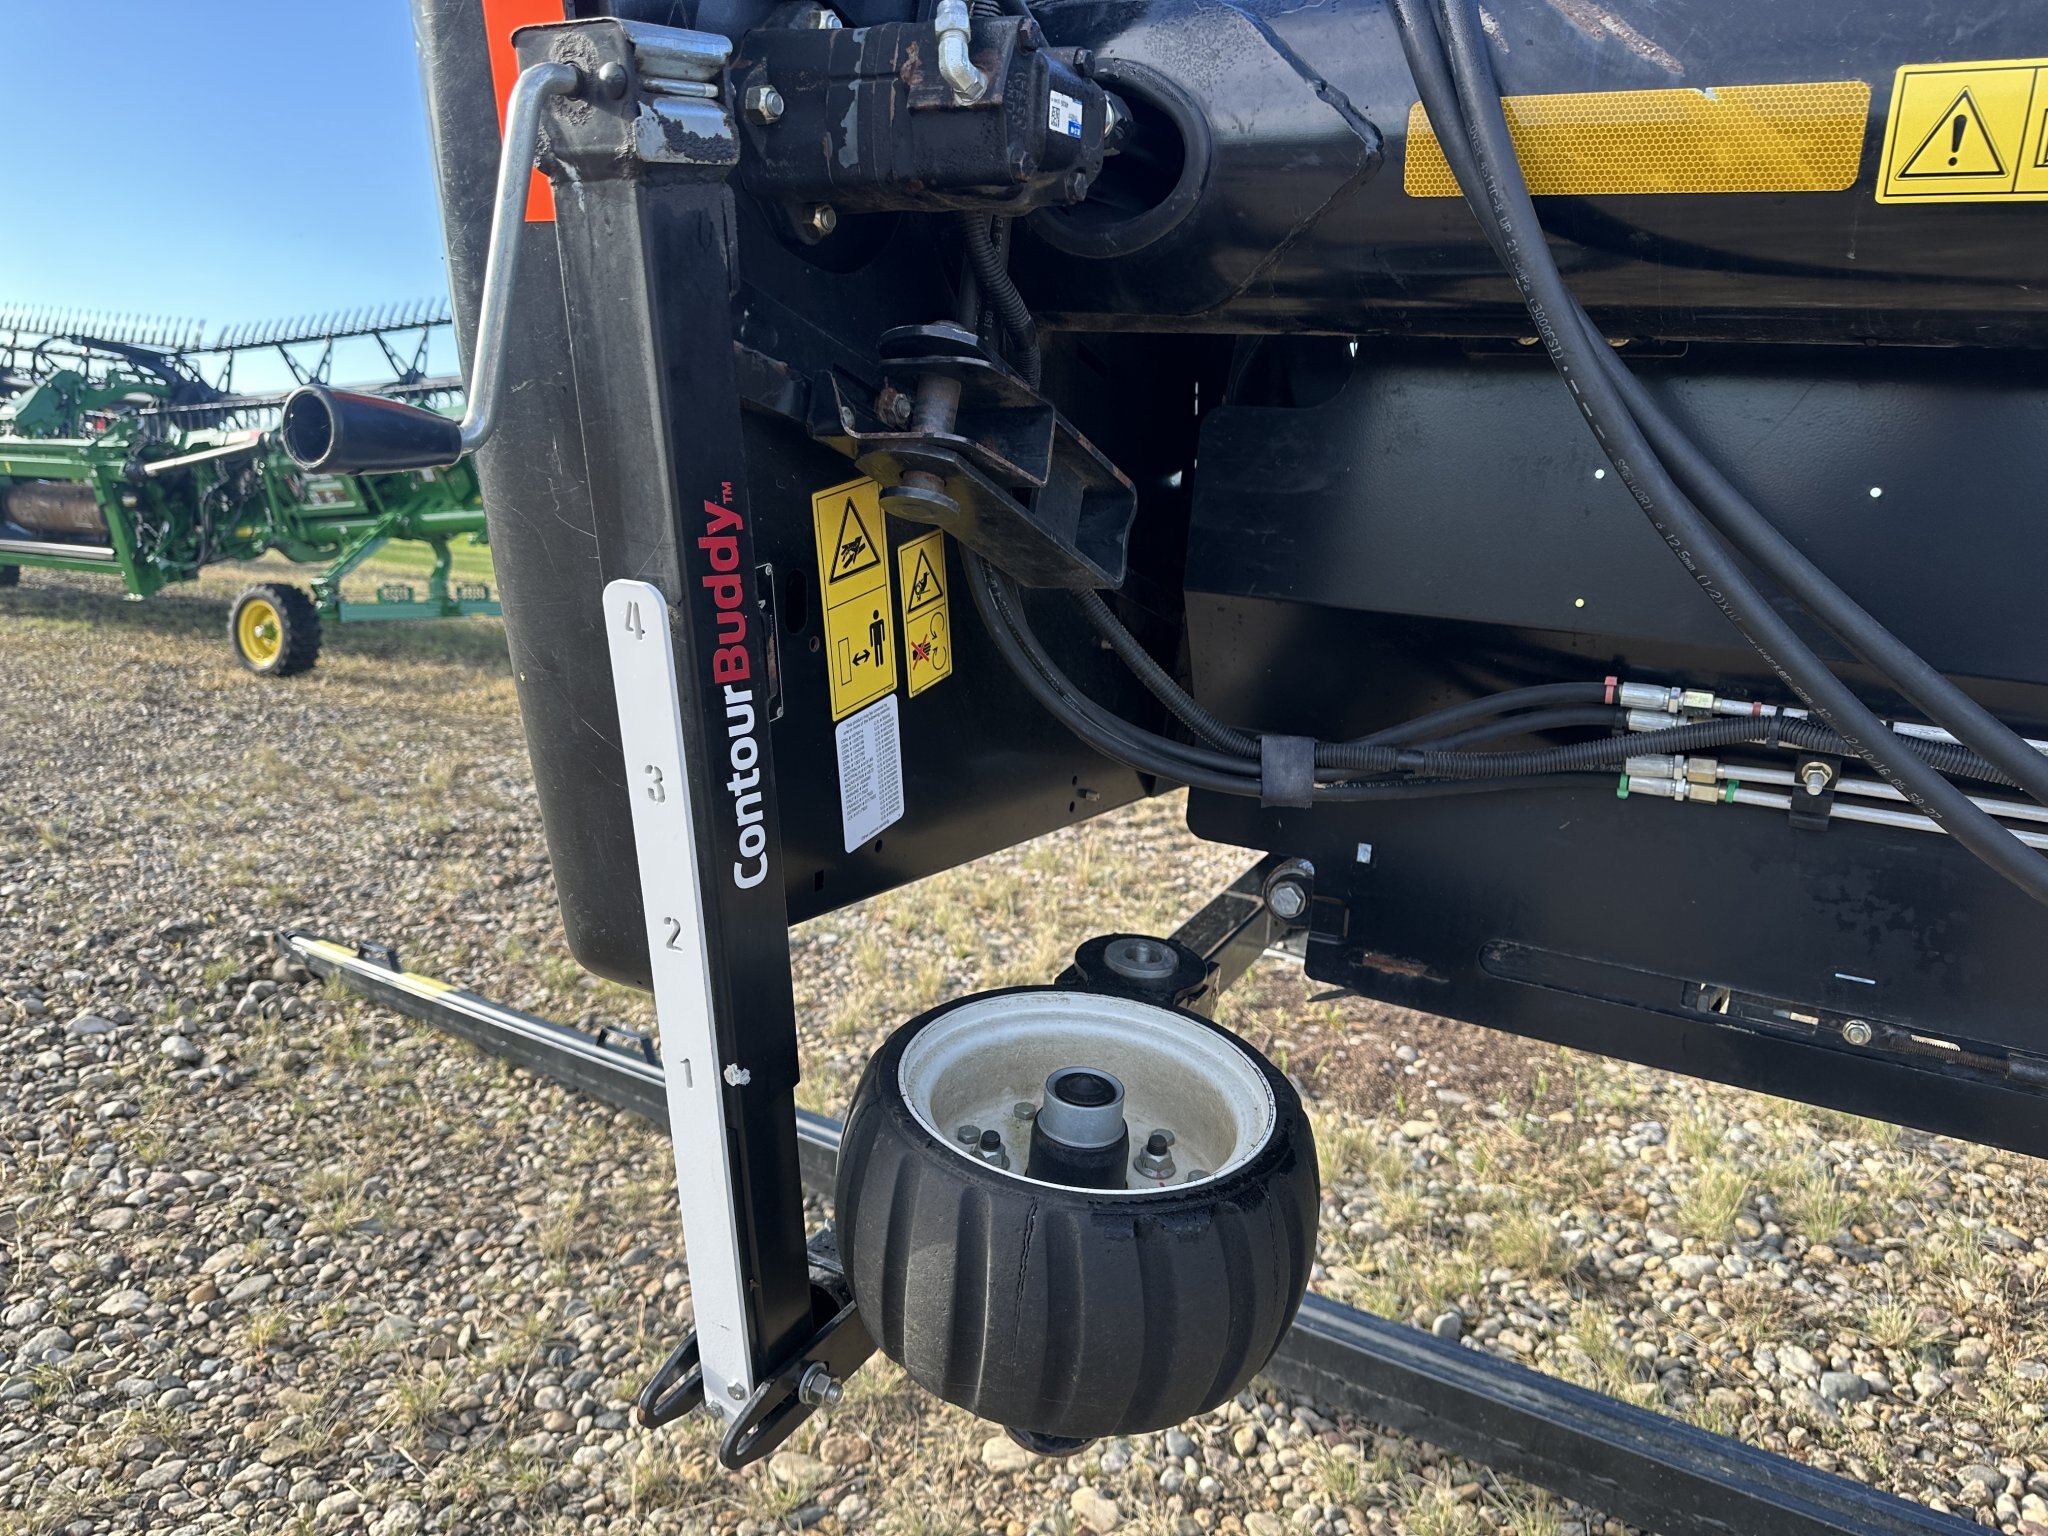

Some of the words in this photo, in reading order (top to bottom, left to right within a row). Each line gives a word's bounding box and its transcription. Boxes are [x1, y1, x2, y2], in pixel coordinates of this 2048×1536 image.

[1665, 533, 1697, 571] 12.5mm
[625, 601, 646, 641] 4
[645, 764, 666, 804] 3
[663, 916, 684, 953] 2
[680, 1058, 694, 1089] 1
